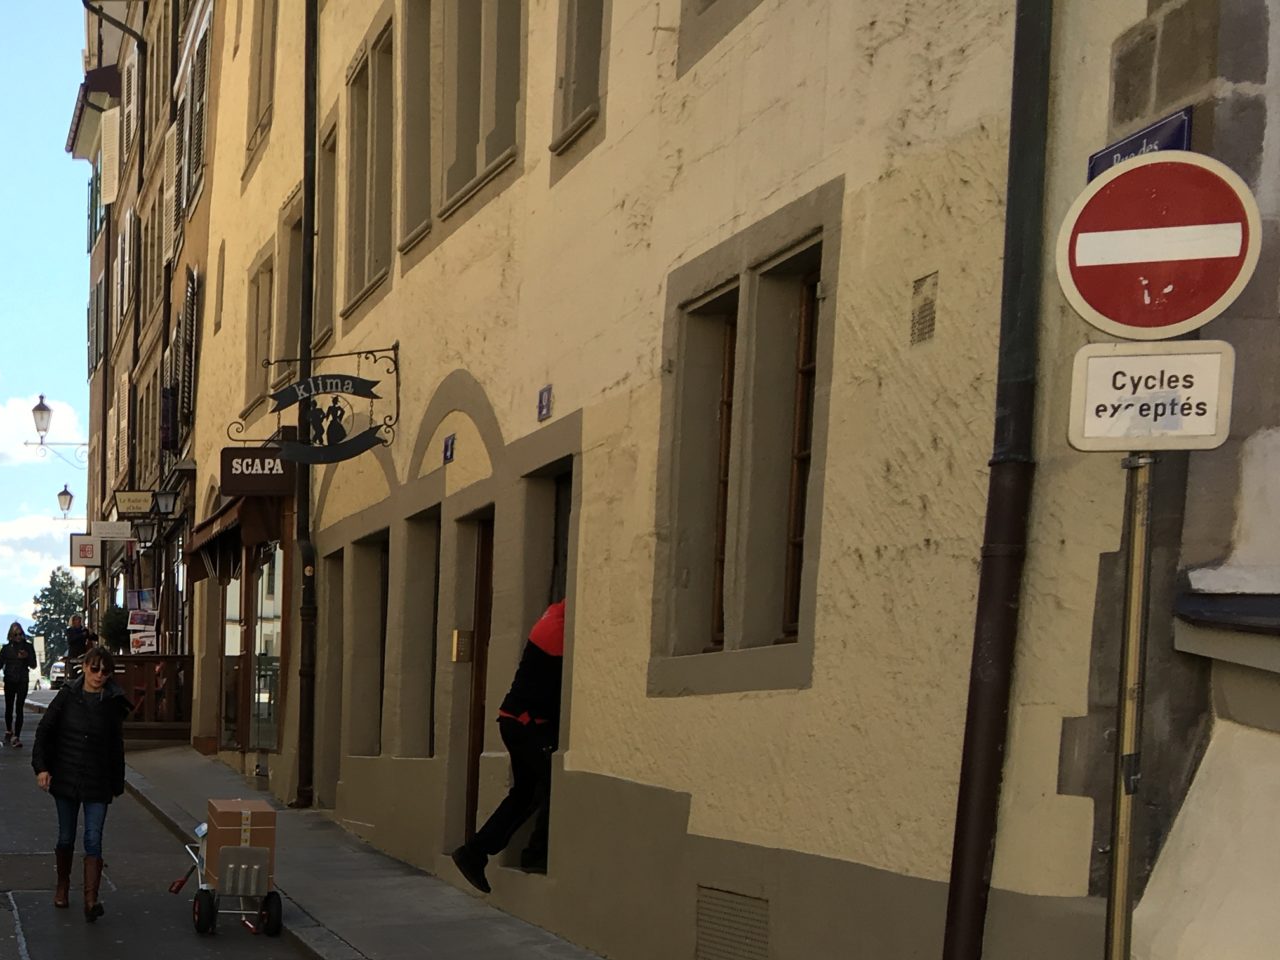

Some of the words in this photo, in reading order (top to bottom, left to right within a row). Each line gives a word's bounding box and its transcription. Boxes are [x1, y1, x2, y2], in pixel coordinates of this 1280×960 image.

[1139, 138, 1159, 155] des
[293, 377, 354, 400] klima
[1111, 369, 1195, 396] Cycles
[231, 458, 284, 475] SCAPA
